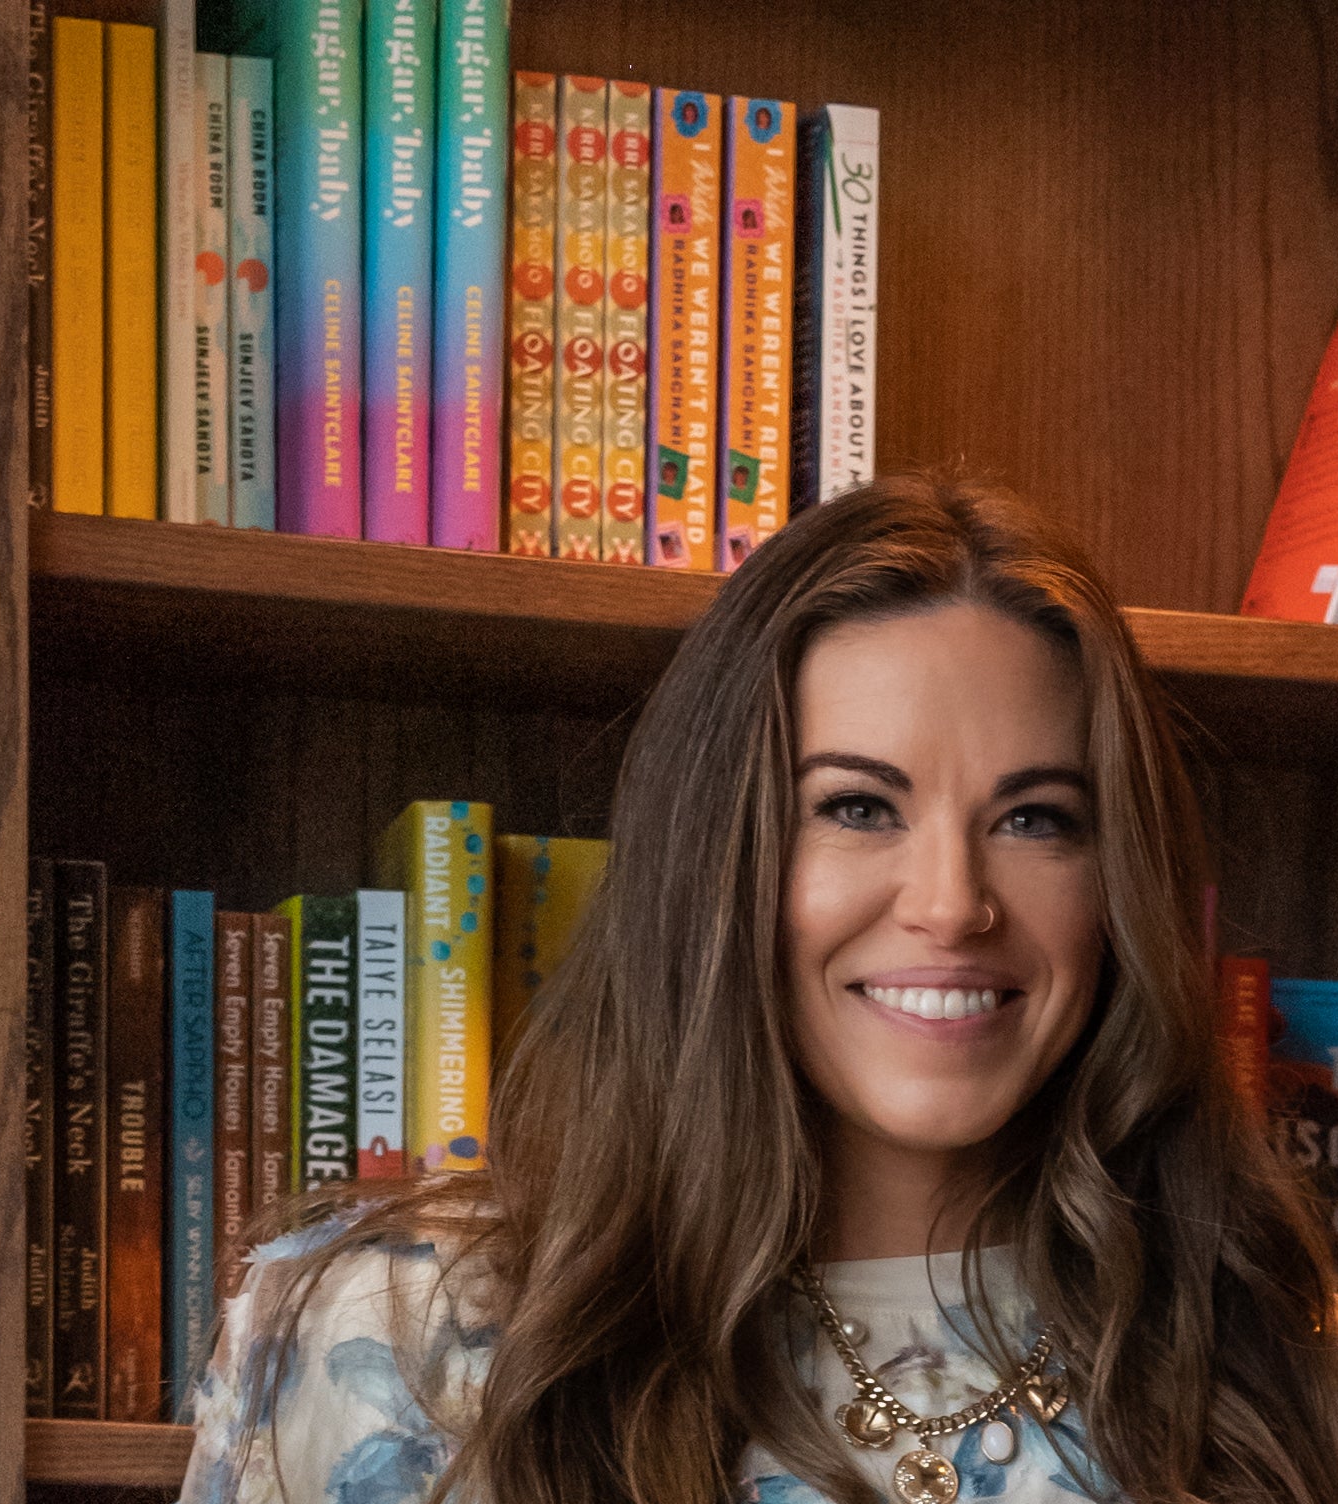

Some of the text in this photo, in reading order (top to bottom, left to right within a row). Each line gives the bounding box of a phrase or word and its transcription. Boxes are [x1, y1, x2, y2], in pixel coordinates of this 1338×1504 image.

[251, 110, 266, 160] CHINA
[464, 285, 482, 492] CELINE SAINTCLARE
[686, 237, 711, 546] WE WEREN'T RELATED
[842, 152, 874, 462] 30 THINGS LOVE ABOUT
[615, 313, 638, 518] FLOATING CITY
[260, 999, 285, 1062] Empty
[307, 936, 350, 1007] THE
[364, 923, 398, 1115] TAIYE SELASI
[424, 816, 468, 1132] RADIANT SHIMMERING
[120, 1080, 145, 1193] TROUBLE
